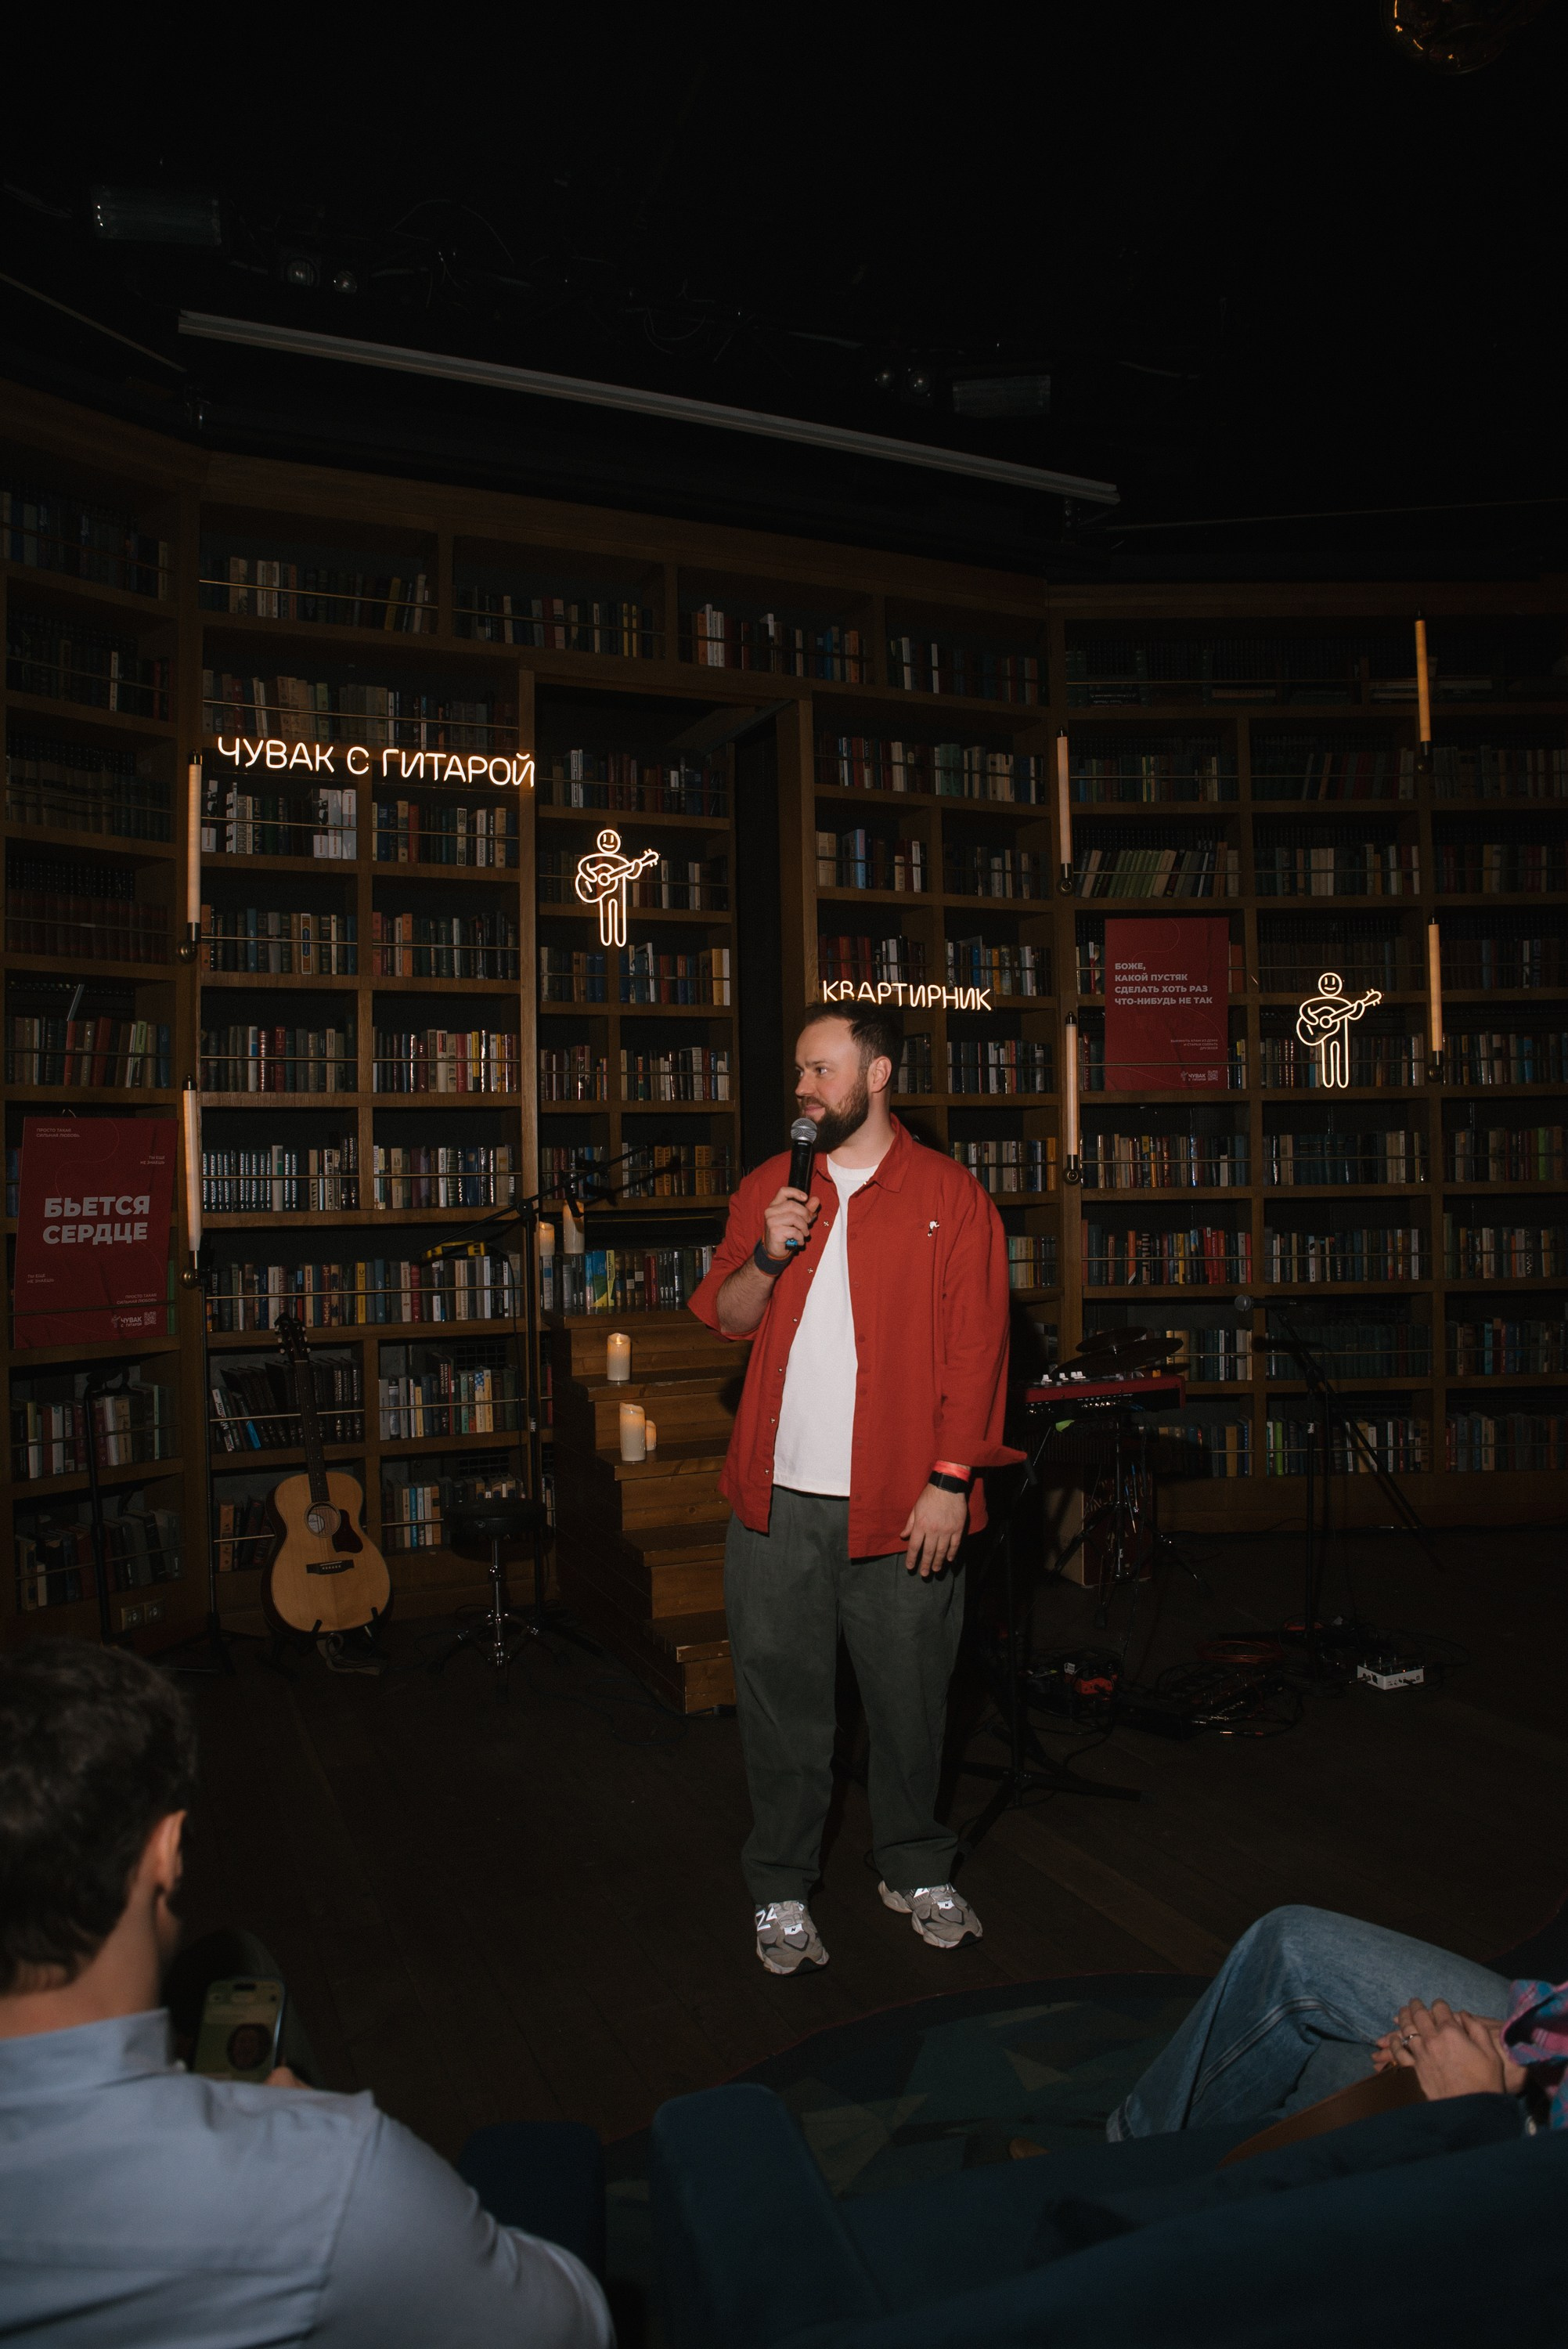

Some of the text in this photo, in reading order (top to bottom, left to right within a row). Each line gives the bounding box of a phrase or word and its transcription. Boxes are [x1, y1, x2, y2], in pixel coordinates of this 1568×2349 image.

[218, 736, 535, 788] ЧУВАК С ГИТАРОЙ
[1115, 962, 1146, 971] БОЖЕ,
[1115, 972, 1148, 982] КАКОЙ
[1115, 986, 1159, 994] СДЕЛАТЬ
[44, 1195, 150, 1218] БЬЕТСЯ
[42, 1222, 148, 1245] СЕРДЦЕ
